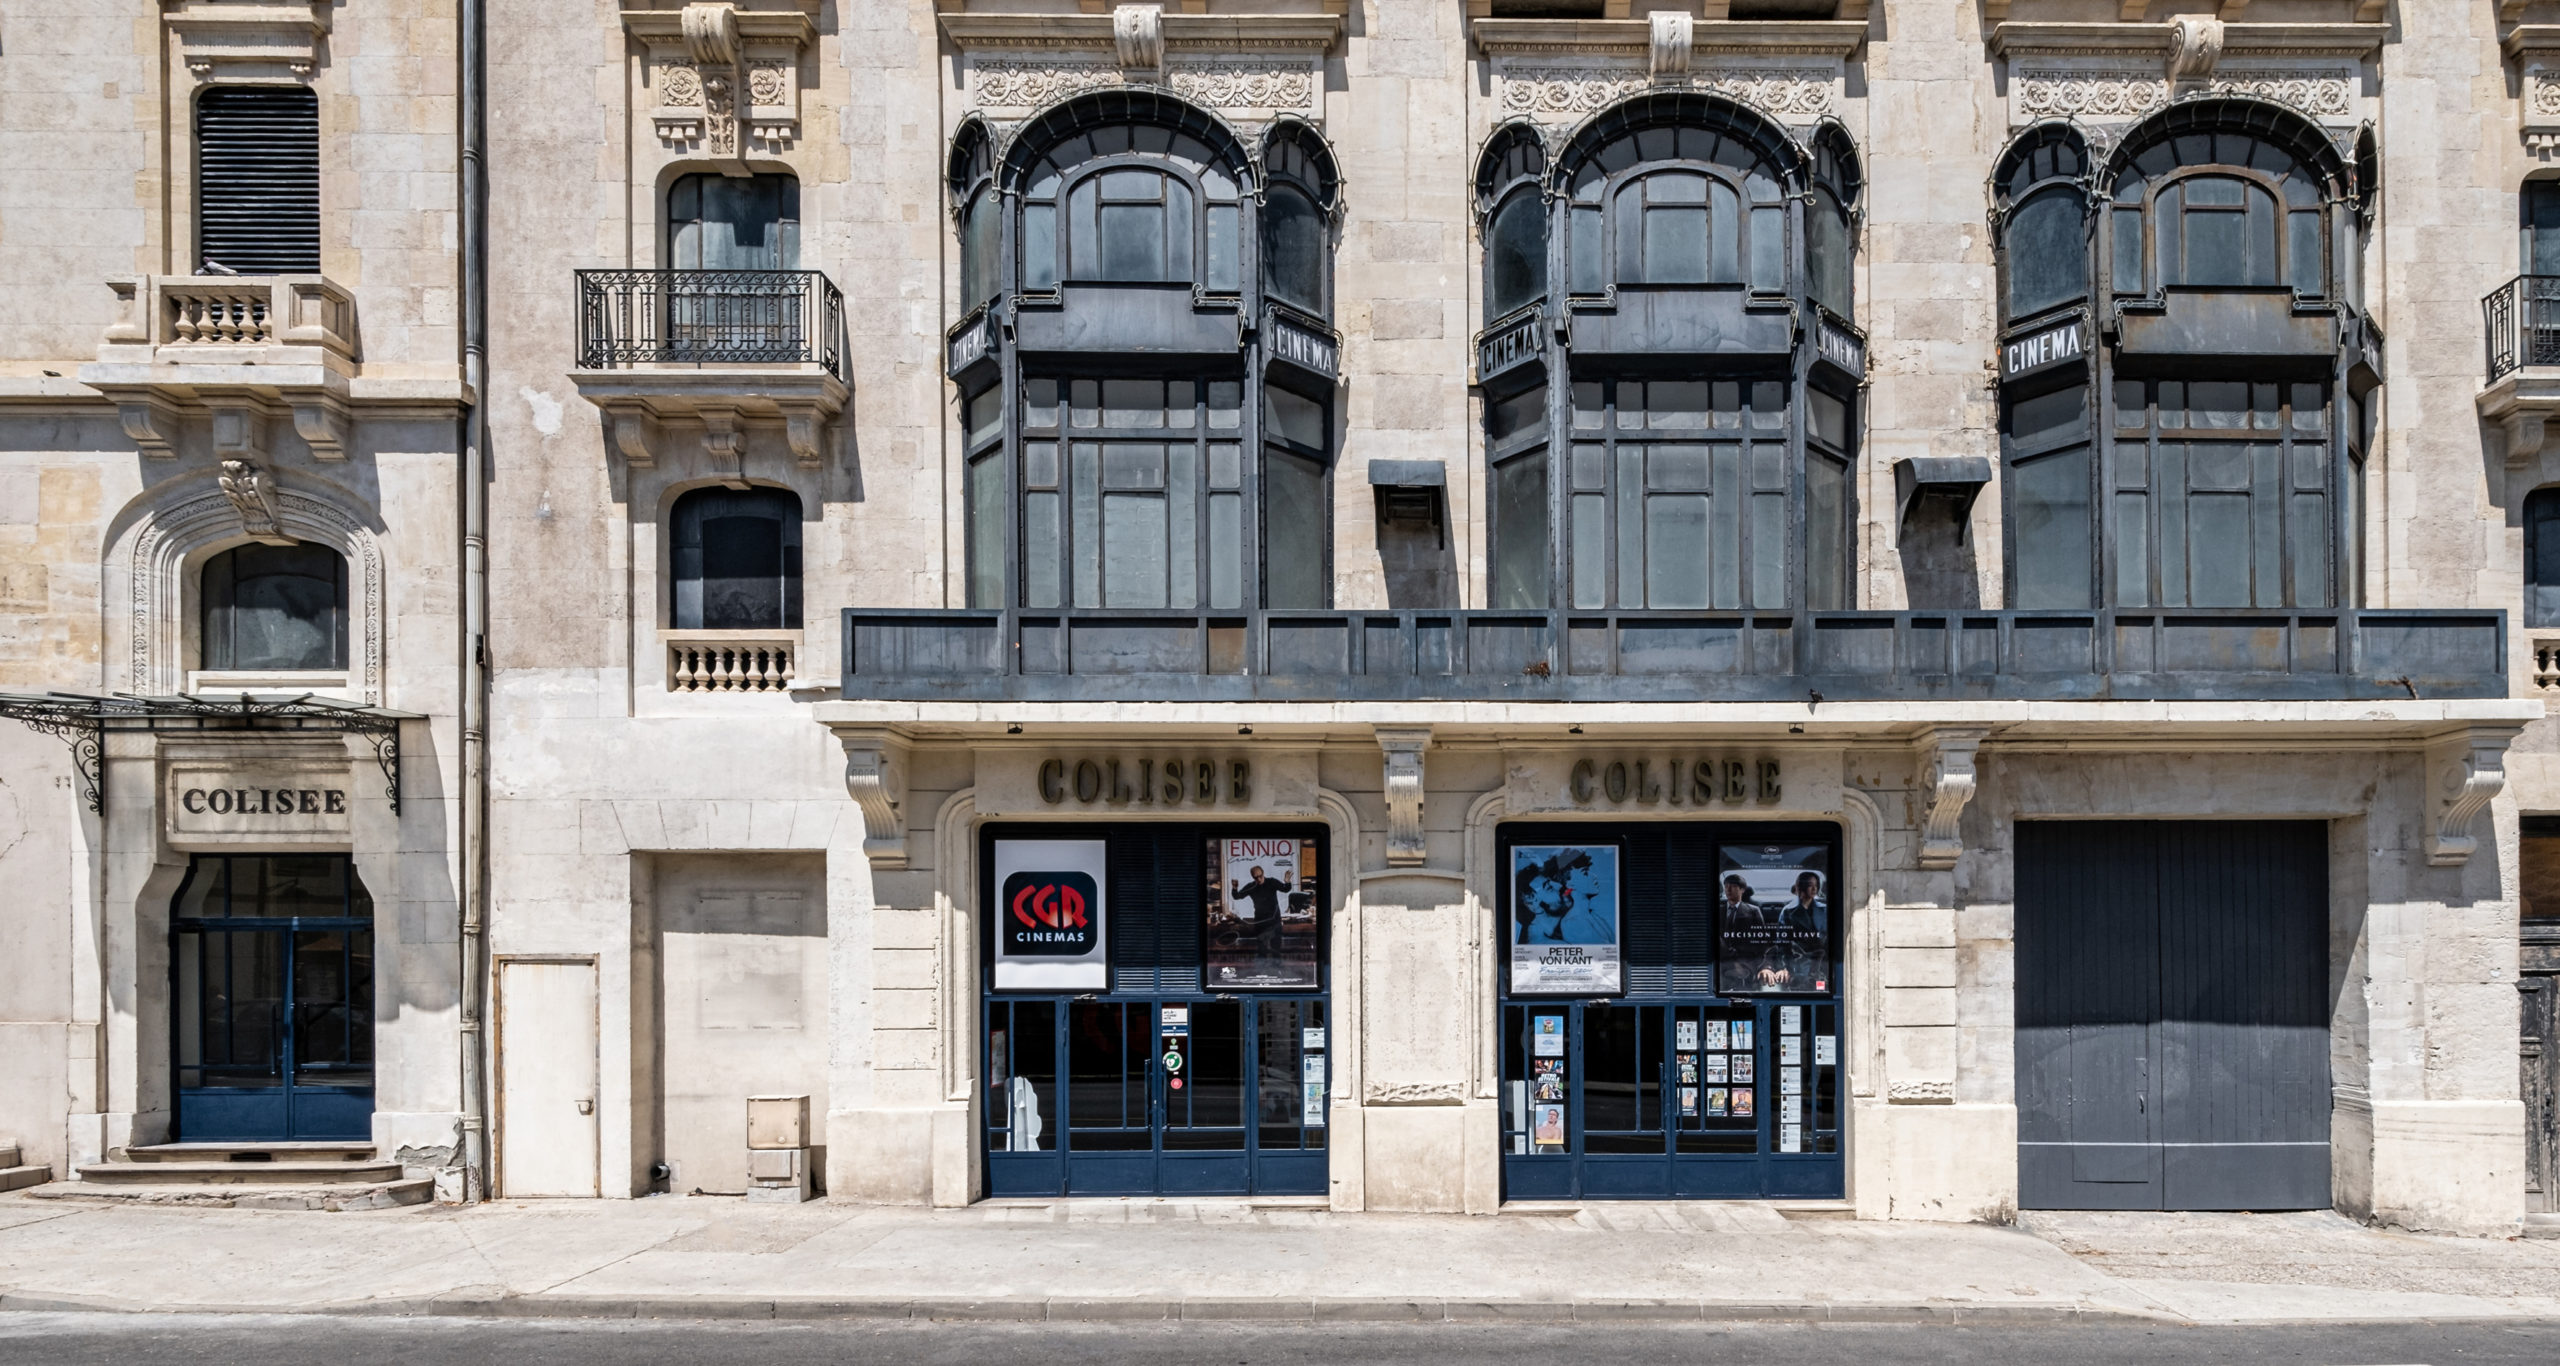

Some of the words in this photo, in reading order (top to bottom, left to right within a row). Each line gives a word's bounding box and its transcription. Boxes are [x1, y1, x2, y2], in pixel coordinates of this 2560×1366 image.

[953, 320, 986, 370] CINEMA
[1276, 324, 1333, 373] CINEMA
[1484, 324, 1535, 374] CINEMA
[1822, 325, 1860, 374] CINEMA
[2008, 325, 2080, 374] CINEMA
[182, 788, 346, 815] COLISEE
[1037, 758, 1250, 806] COLISEE
[1570, 757, 1782, 806] COLISEE
[1230, 839, 1292, 857] ENNIO
[1013, 883, 1088, 929] CGR
[1016, 932, 1085, 942] CINEMAS
[1539, 956, 1562, 965] VON
[1564, 956, 1593, 965] KANT
[1549, 947, 1584, 956] PETER
